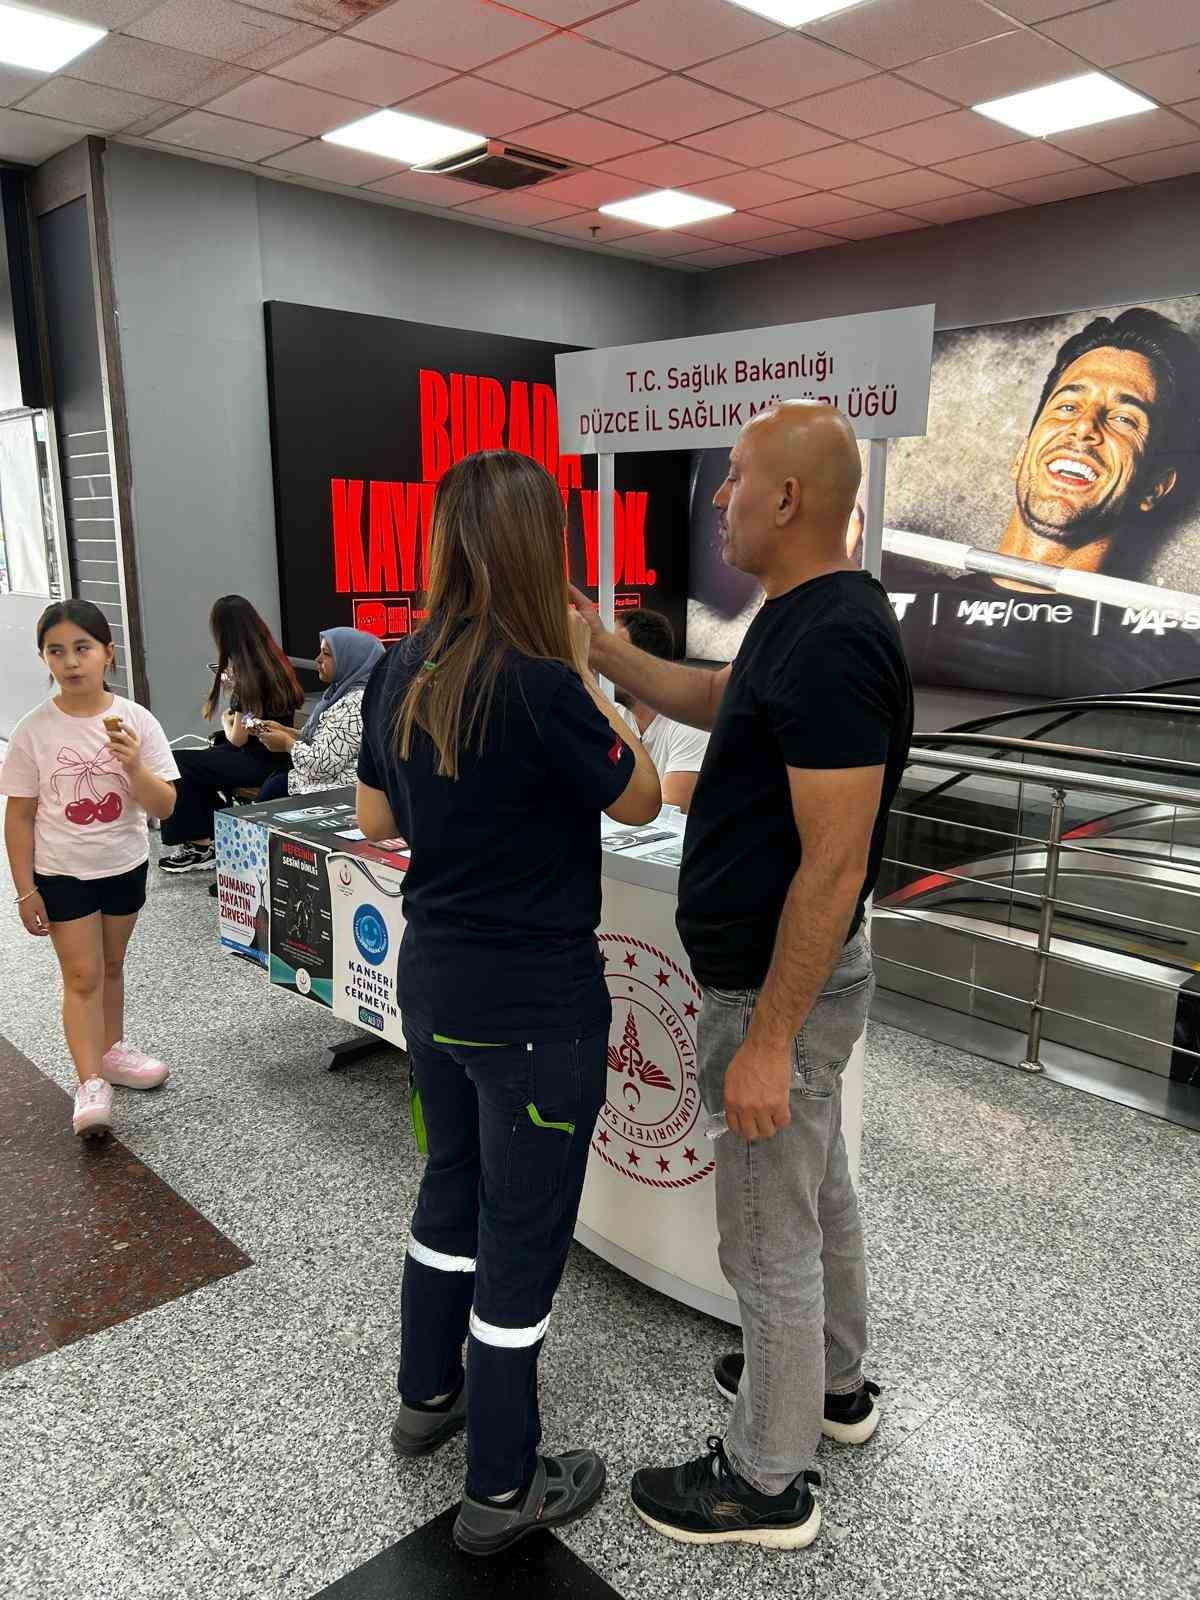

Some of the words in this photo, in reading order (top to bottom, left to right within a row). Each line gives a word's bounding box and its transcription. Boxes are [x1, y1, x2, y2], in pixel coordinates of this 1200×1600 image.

[626, 370, 661, 393] T.C.
[667, 363, 728, 393] Sağlık
[735, 350, 833, 384] Bakanlığı
[580, 408, 639, 435] DÜZCE
[645, 405, 663, 431] İL
[668, 400, 742, 430] SAĞLIK
[218, 874, 256, 898] DUMANSIZ
[220, 889, 251, 913] HAYATIN
[348, 960, 393, 989] KANSERİ
[352, 974, 389, 1000] İÇİNİZE
[345, 985, 397, 1018] ÇEKMEYİN
[658, 1004, 697, 1081] TÜRKİYE
